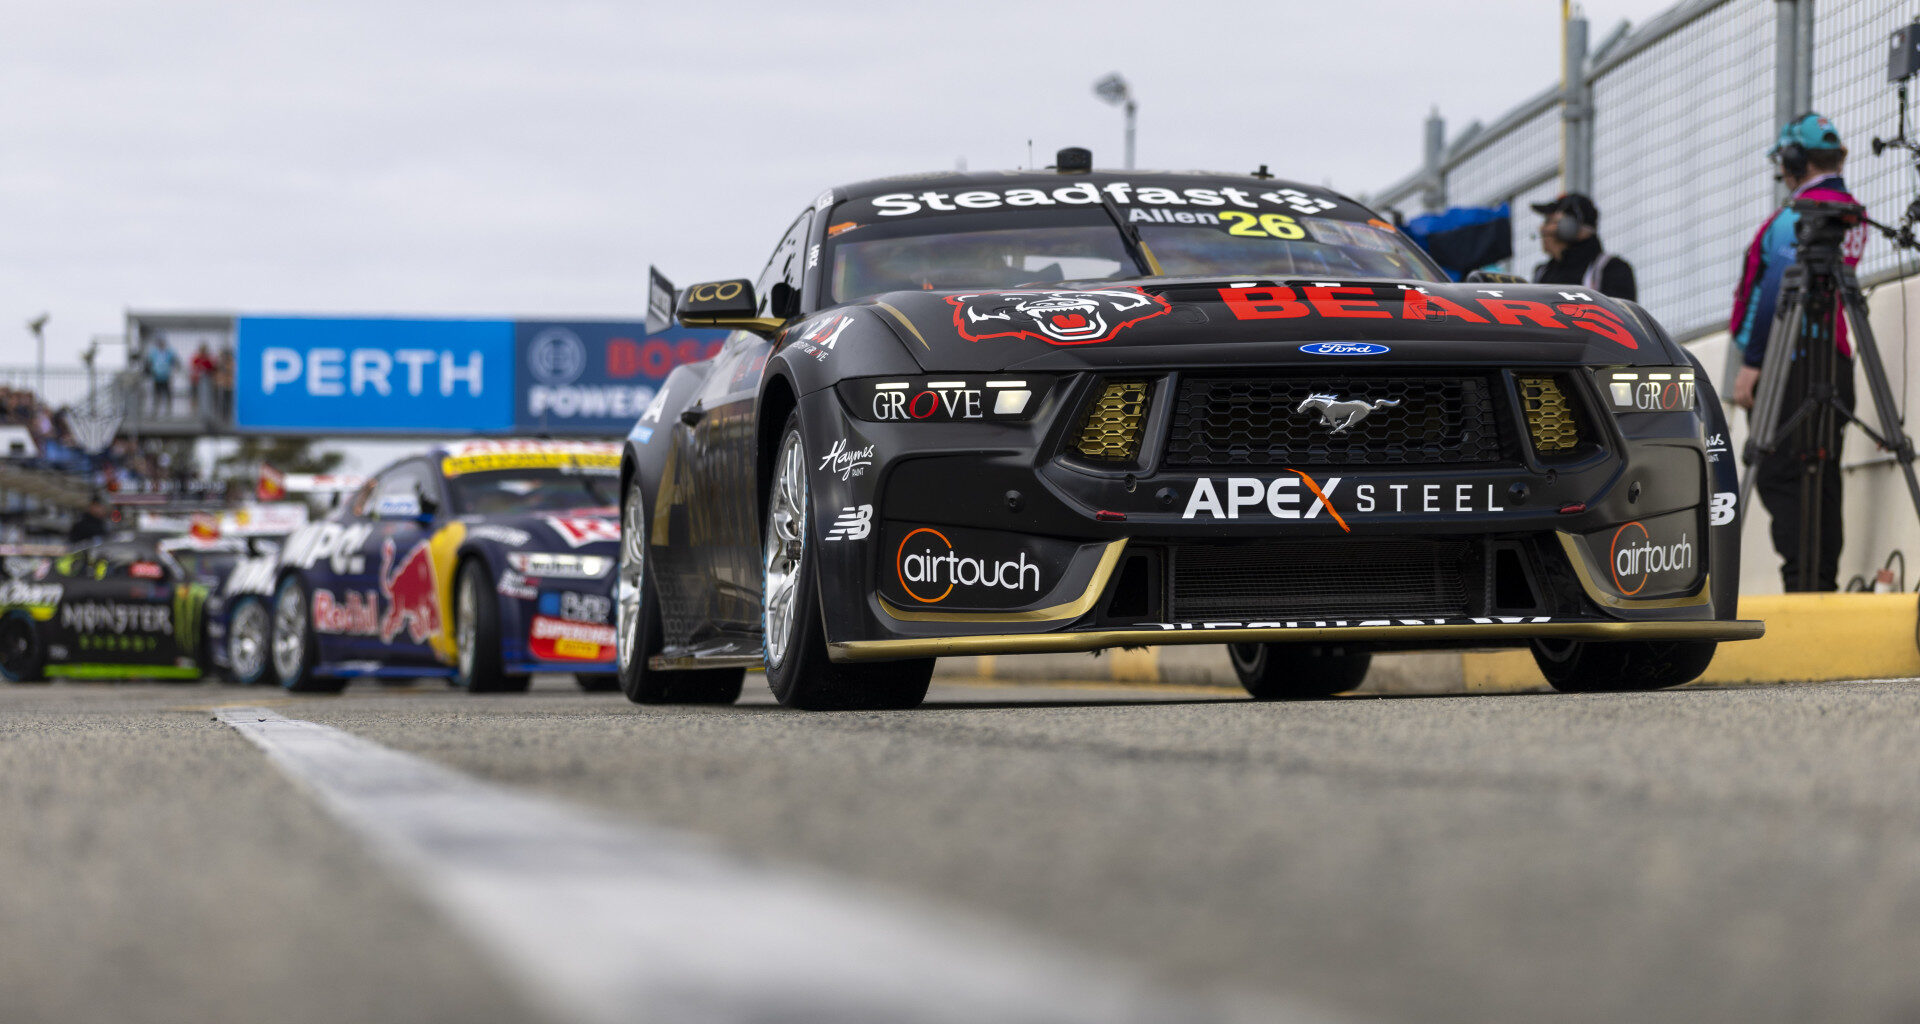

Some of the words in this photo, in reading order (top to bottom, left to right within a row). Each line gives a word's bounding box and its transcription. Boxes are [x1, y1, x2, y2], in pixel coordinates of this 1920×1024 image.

[871, 182, 1259, 216] Steadfast
[1129, 207, 1220, 225] Allen
[1218, 211, 1306, 240] 26
[1217, 286, 1639, 350] BEARS
[261, 346, 484, 397] PERTH
[606, 337, 722, 380] BOS
[872, 389, 984, 420] GROVE
[818, 438, 875, 482] Haymes
[1182, 472, 1347, 527] APEX
[1356, 484, 1505, 513] STEEL
[904, 548, 1041, 592] airtouch
[1616, 532, 1692, 577] airtouch
[61, 600, 174, 635] MONSTER
